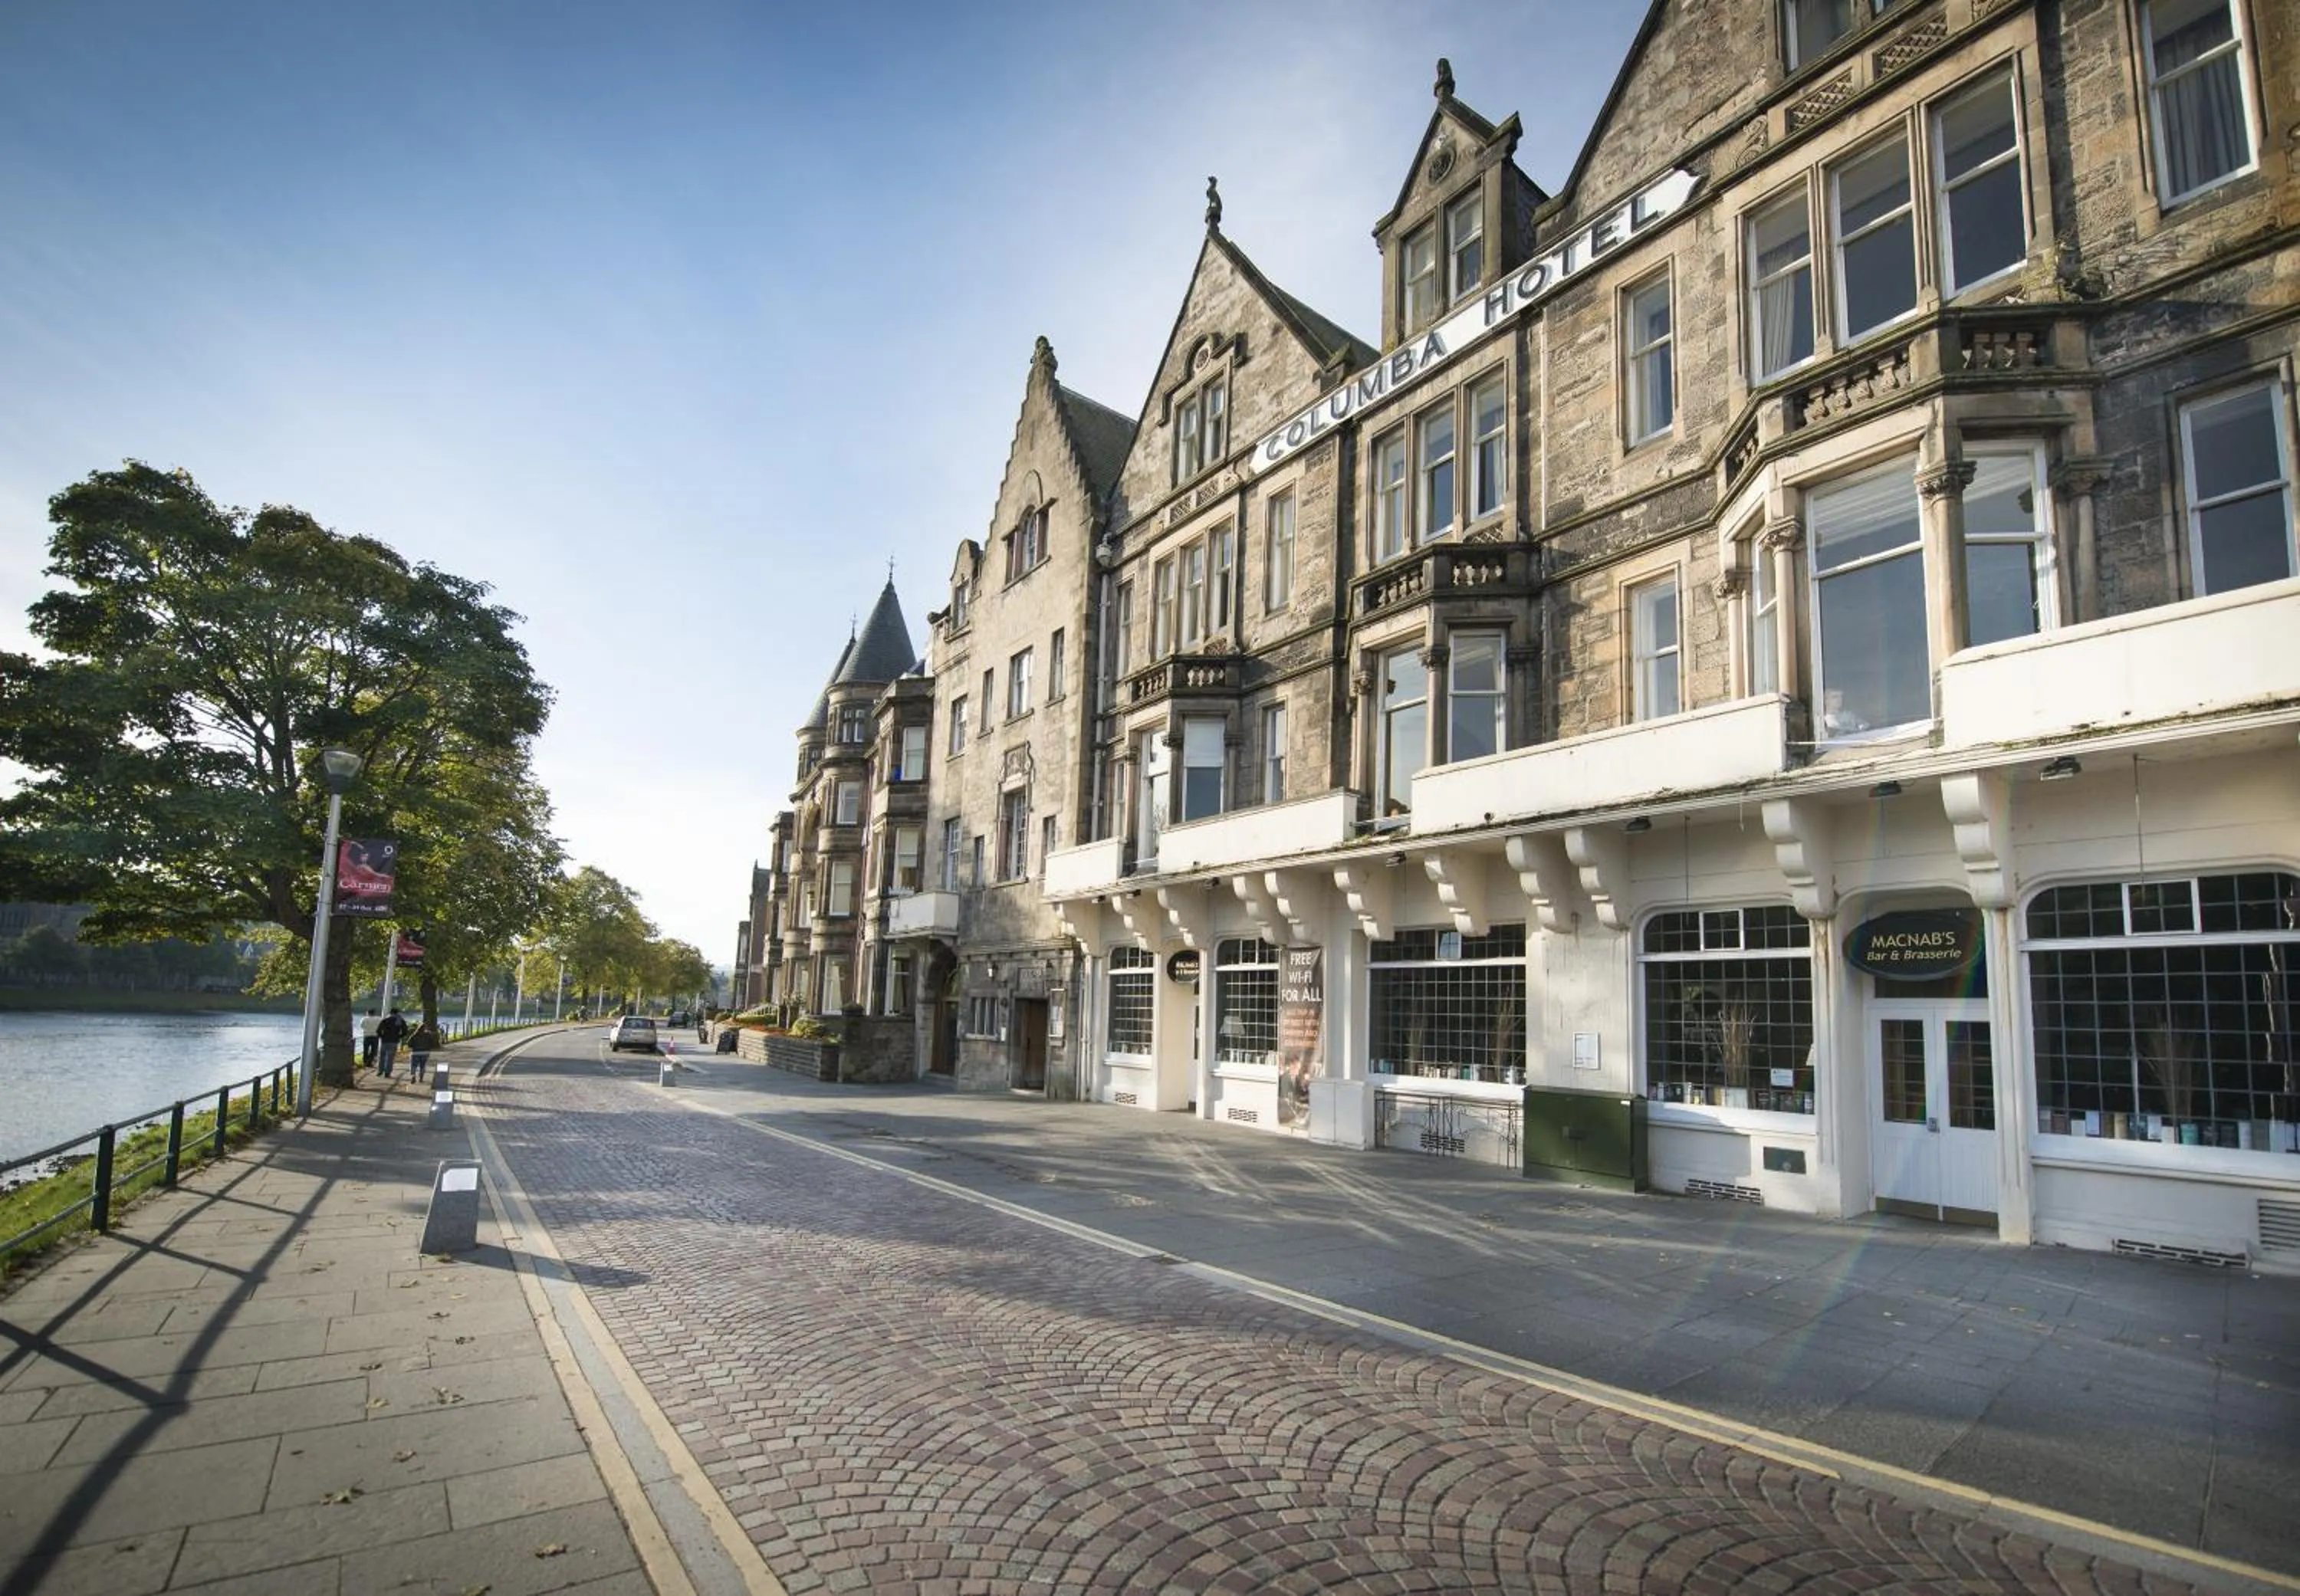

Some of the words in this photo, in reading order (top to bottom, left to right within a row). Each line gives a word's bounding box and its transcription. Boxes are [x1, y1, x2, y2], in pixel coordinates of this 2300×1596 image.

[1266, 330, 1447, 461] COLUMBA
[1484, 196, 1663, 327] HOTEL
[1871, 931, 1956, 949] MACNAB'S
[1290, 951, 1312, 966] FREE
[1867, 951, 1888, 961] Bar
[1890, 950, 1901, 961] &
[1904, 948, 1963, 960] Brasserie
[1288, 970, 1313, 984] WI-FI
[1281, 989, 1299, 1002] FOR
[1302, 987, 1322, 1002] ALL
